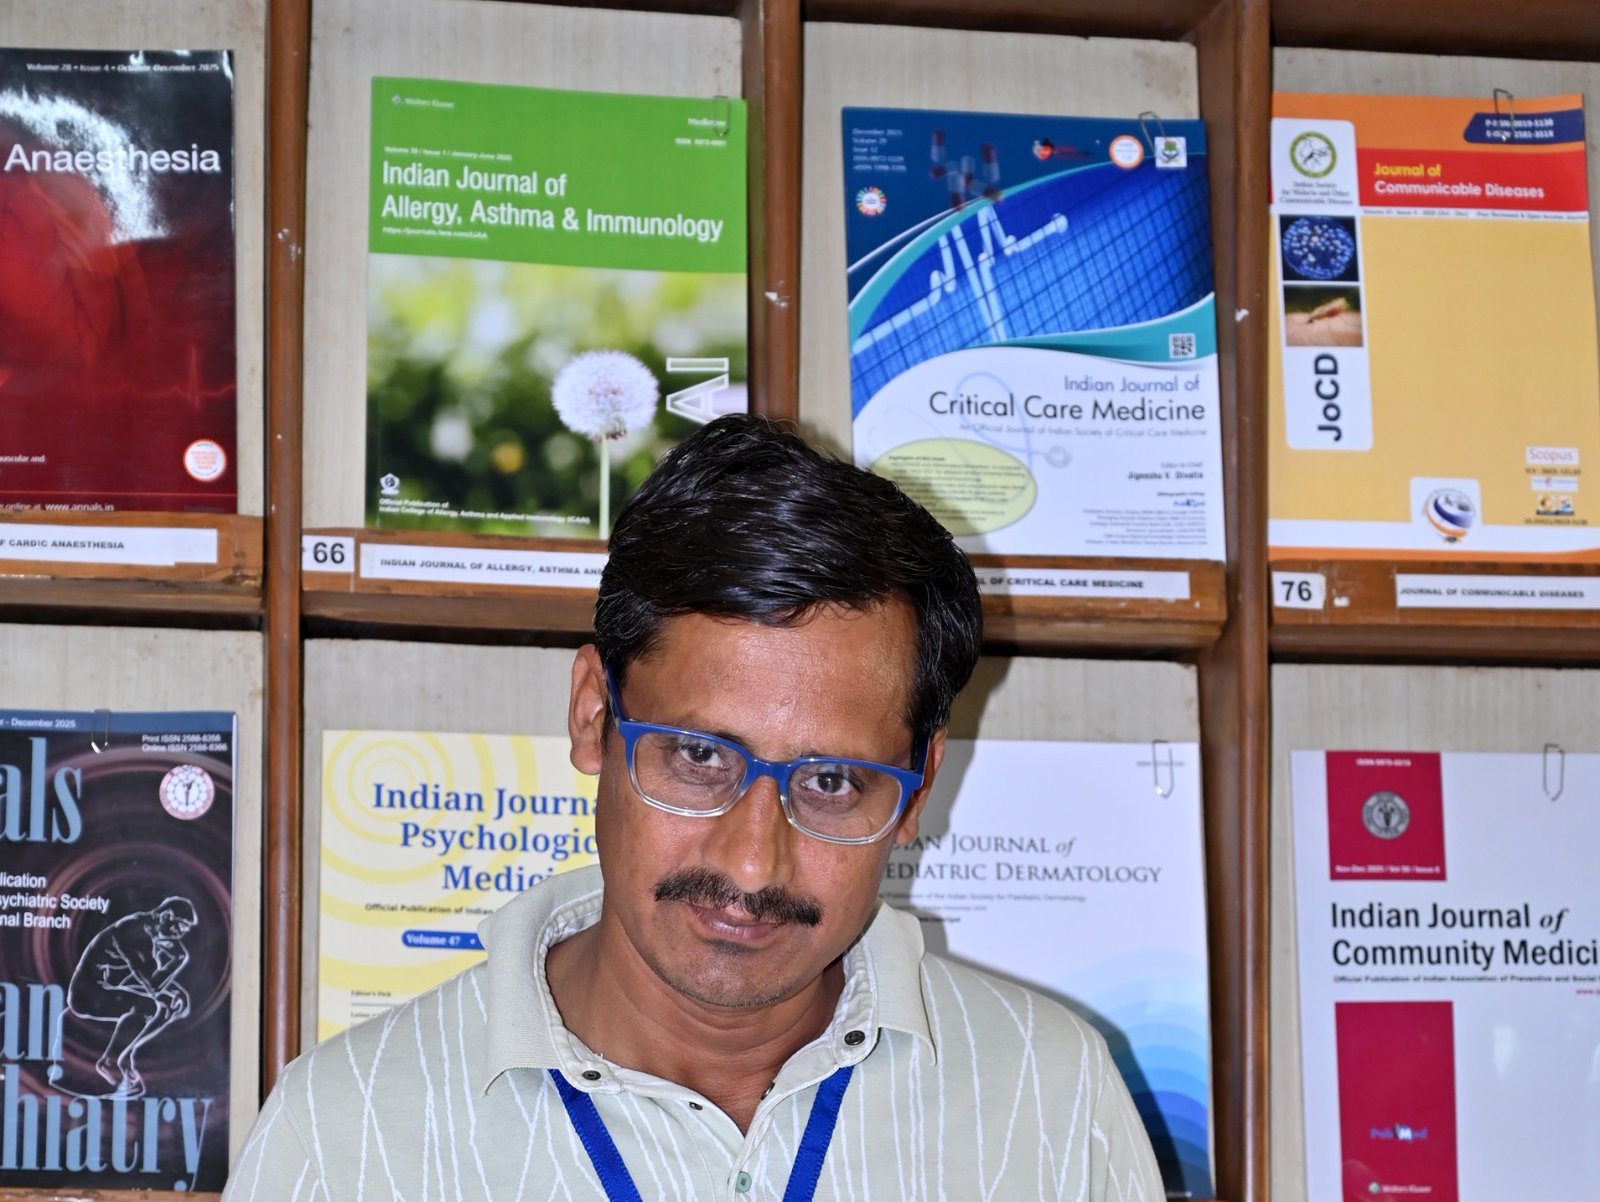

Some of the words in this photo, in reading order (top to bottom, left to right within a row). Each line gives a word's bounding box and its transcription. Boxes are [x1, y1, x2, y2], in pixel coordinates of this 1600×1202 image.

[4, 144, 221, 172] Anaesthesia
[383, 160, 449, 188] Indian
[456, 165, 538, 194] Journal
[545, 174, 567, 196] of
[1374, 163, 1425, 177] Journal
[1429, 163, 1441, 177] of
[1374, 180, 1481, 197] Communicable
[1485, 183, 1545, 199] Diseases
[382, 195, 463, 226] Allergy,
[470, 200, 555, 229] Asthma
[562, 208, 579, 231] &
[586, 209, 724, 243] Immunology
[1064, 376, 1114, 392] Indian
[1120, 375, 1179, 393] Journal
[1184, 375, 1200, 391] of
[1313, 353, 1342, 442] JoCD
[929, 392, 1015, 417] Critical
[1024, 395, 1082, 420] Care
[1092, 397, 1206, 422] Medicine
[975, 424, 1002, 432] Official
[1076, 428, 1103, 437] Society
[1171, 428, 1207, 436] Medicine
[30, 455, 45, 463] and
[1529, 448, 1573, 463] Scopus
[404, 499, 442, 508] Publication
[9, 539, 48, 547] CARDIC
[51, 540, 125, 549] ANAESTHESIA
[313, 542, 345, 565] 66
[381, 558, 415, 567] INDIAN
[419, 559, 466, 569] JOURNAL
[487, 563, 535, 573] ALLERGY,
[538, 565, 580, 575] ASTHMA
[990, 576, 1005, 585] OF
[1008, 577, 1056, 587] CRITICAL
[1060, 578, 1089, 587] CARE
[1092, 579, 1144, 589] MEDICINE
[1281, 581, 1312, 602] 76
[1400, 587, 1443, 596] JOURNAL
[1447, 587, 1458, 596] OF
[1461, 588, 1536, 598] COMMUNICABLE
[1540, 590, 1585, 598] DISEASES
[11, 718, 53, 729] December
[55, 719, 76, 728] 2025
[142, 734, 159, 742] Print
[161, 734, 180, 742] ISSN
[142, 743, 166, 752] Online
[168, 743, 187, 752] ISSN
[372, 782, 485, 813] Indian
[400, 822, 598, 862] Psychologic
[951, 833, 1050, 855] JOURNAL
[1055, 837, 1077, 858] of
[996, 862, 1161, 883] DERMATOLOGY
[60, 895, 110, 914] Society
[365, 903, 398, 912] Official
[400, 903, 452, 914] Publication
[454, 906, 463, 914] of
[24, 914, 71, 928] Branch
[1331, 902, 1420, 929] Indian
[1428, 902, 1531, 930] Journal
[1539, 908, 1569, 935] of
[406, 934, 446, 946] Volume
[1331, 939, 1496, 972] Community
[1504, 939, 1600, 967] Medici
[1333, 975, 1362, 983] Official
[1365, 975, 1409, 983] Publication
[1424, 975, 1447, 983] Indian
[1450, 975, 1498, 983] Association
[1510, 975, 1551, 983] Preventive
[1555, 975, 1569, 983] and
